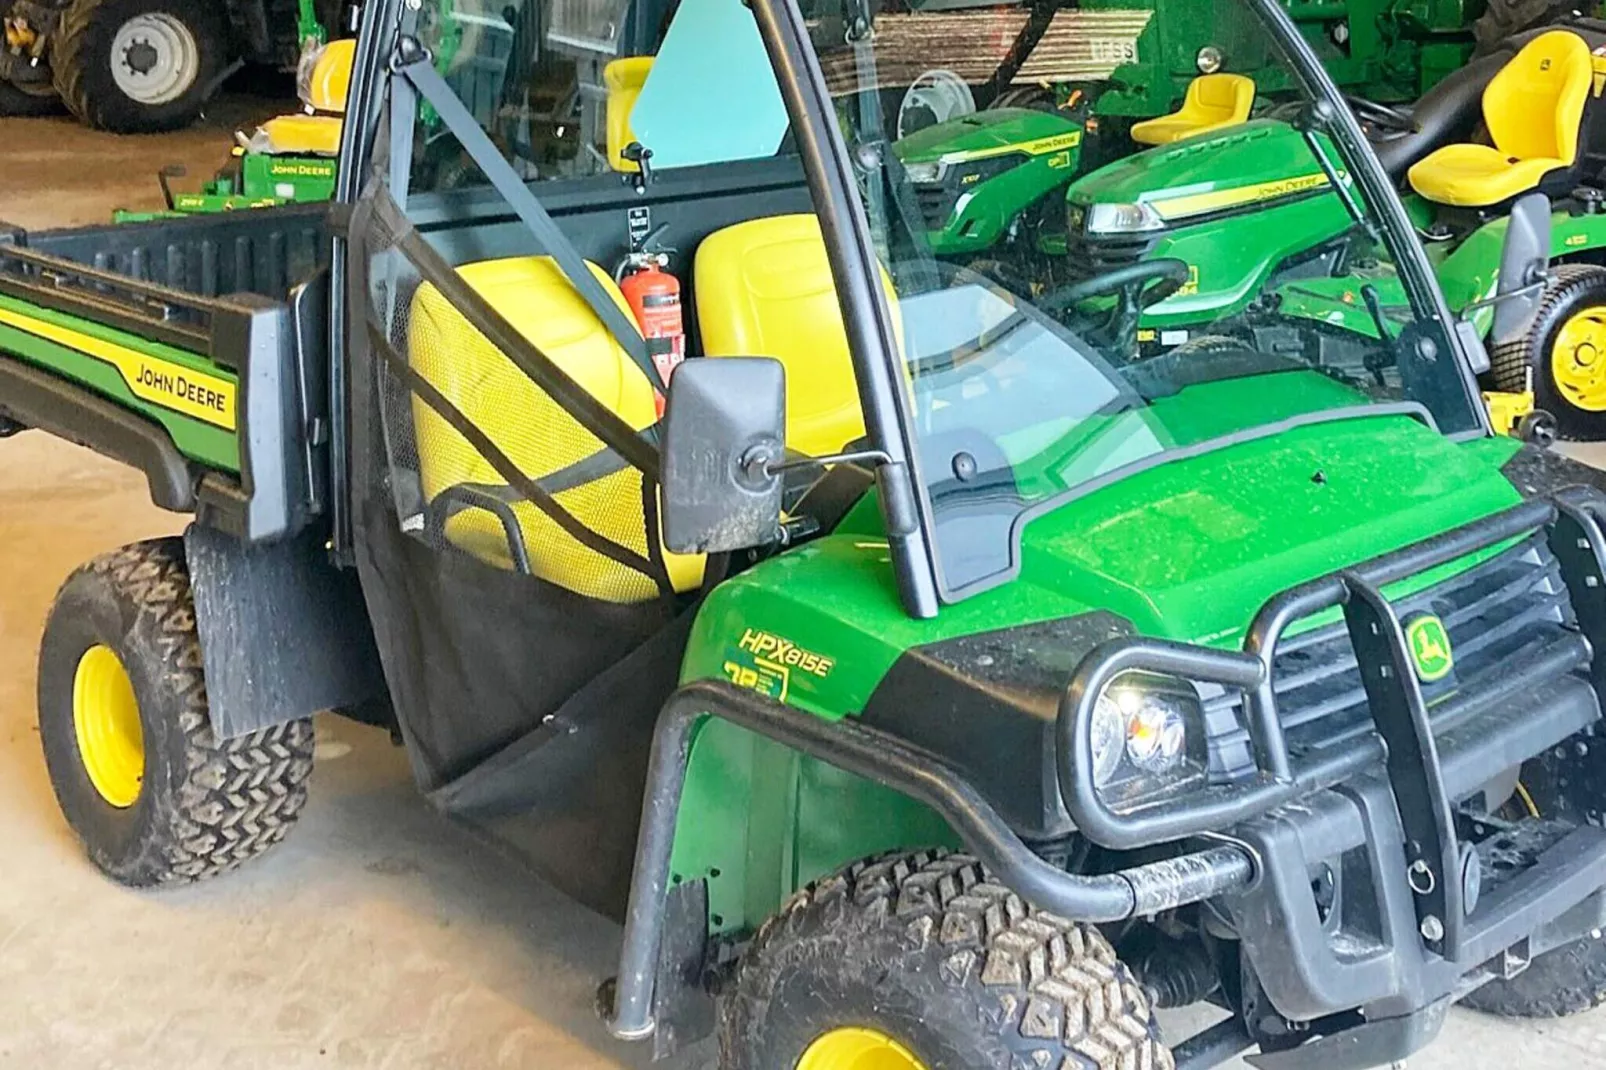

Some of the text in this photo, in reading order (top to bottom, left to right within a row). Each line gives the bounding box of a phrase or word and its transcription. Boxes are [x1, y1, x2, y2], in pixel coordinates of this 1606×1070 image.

[271, 164, 331, 176] JOHN DEERE
[136, 363, 226, 413] JOHN DEERE
[739, 627, 833, 678] HPX815E
